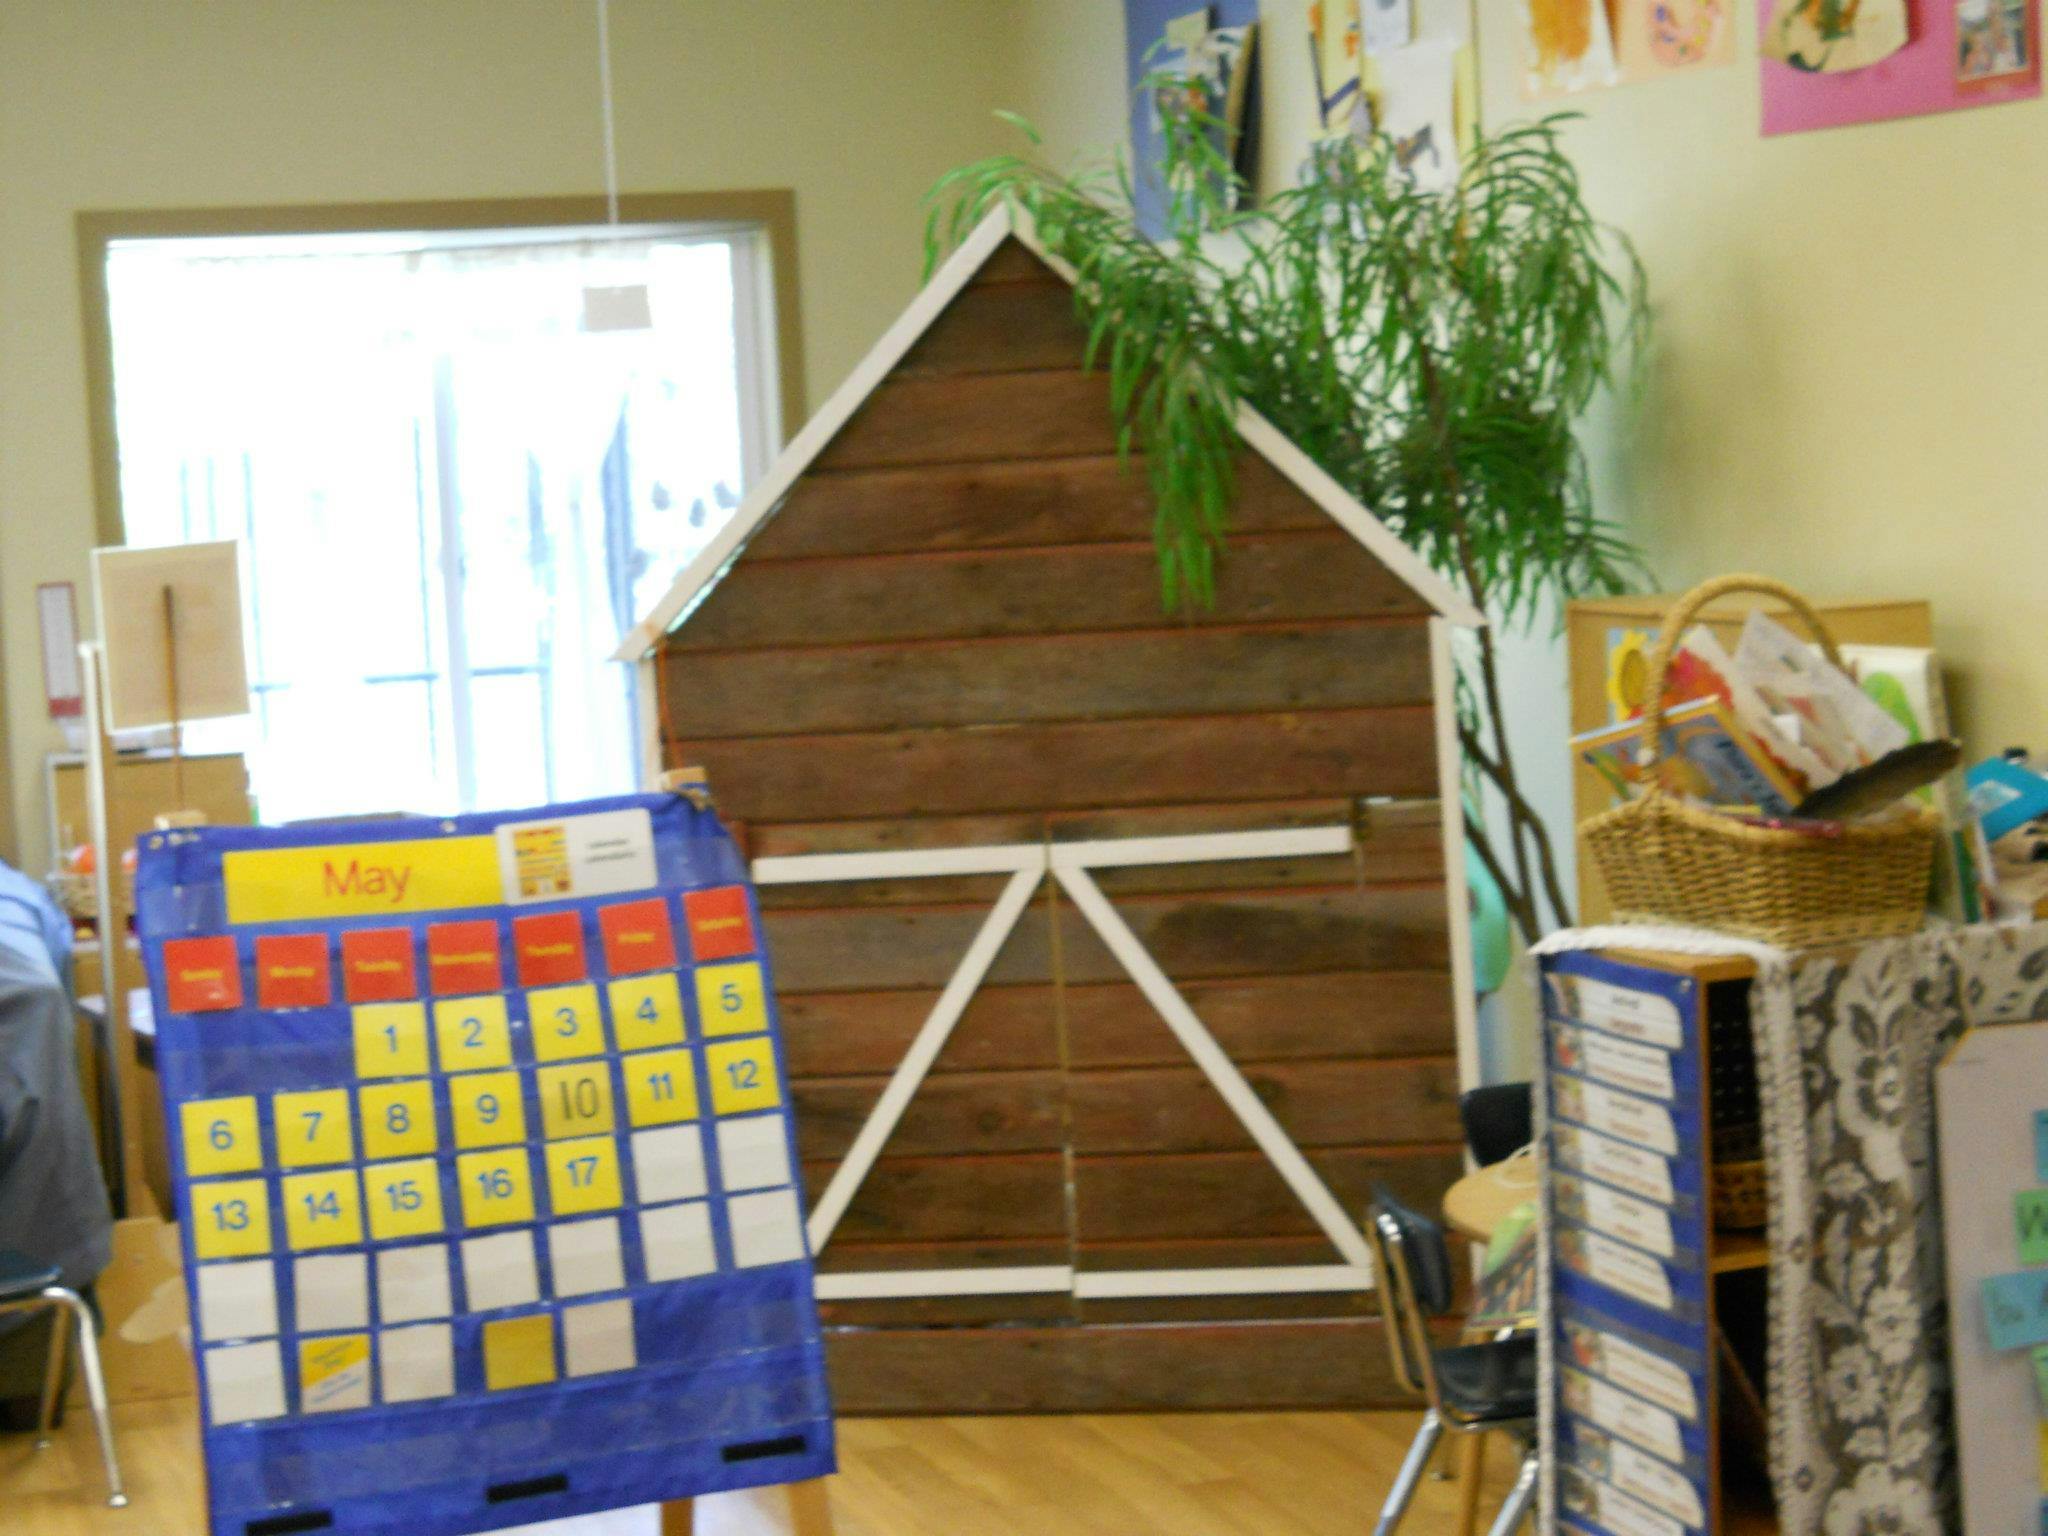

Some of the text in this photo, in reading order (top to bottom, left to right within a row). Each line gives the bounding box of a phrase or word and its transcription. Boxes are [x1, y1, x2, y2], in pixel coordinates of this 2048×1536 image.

[322, 859, 411, 903] May
[382, 982, 744, 1054] 1 2 3 4 5
[208, 1058, 761, 1152] 6 7 8 9 10 11 12
[211, 1155, 600, 1232] 13 14 15 16 17
